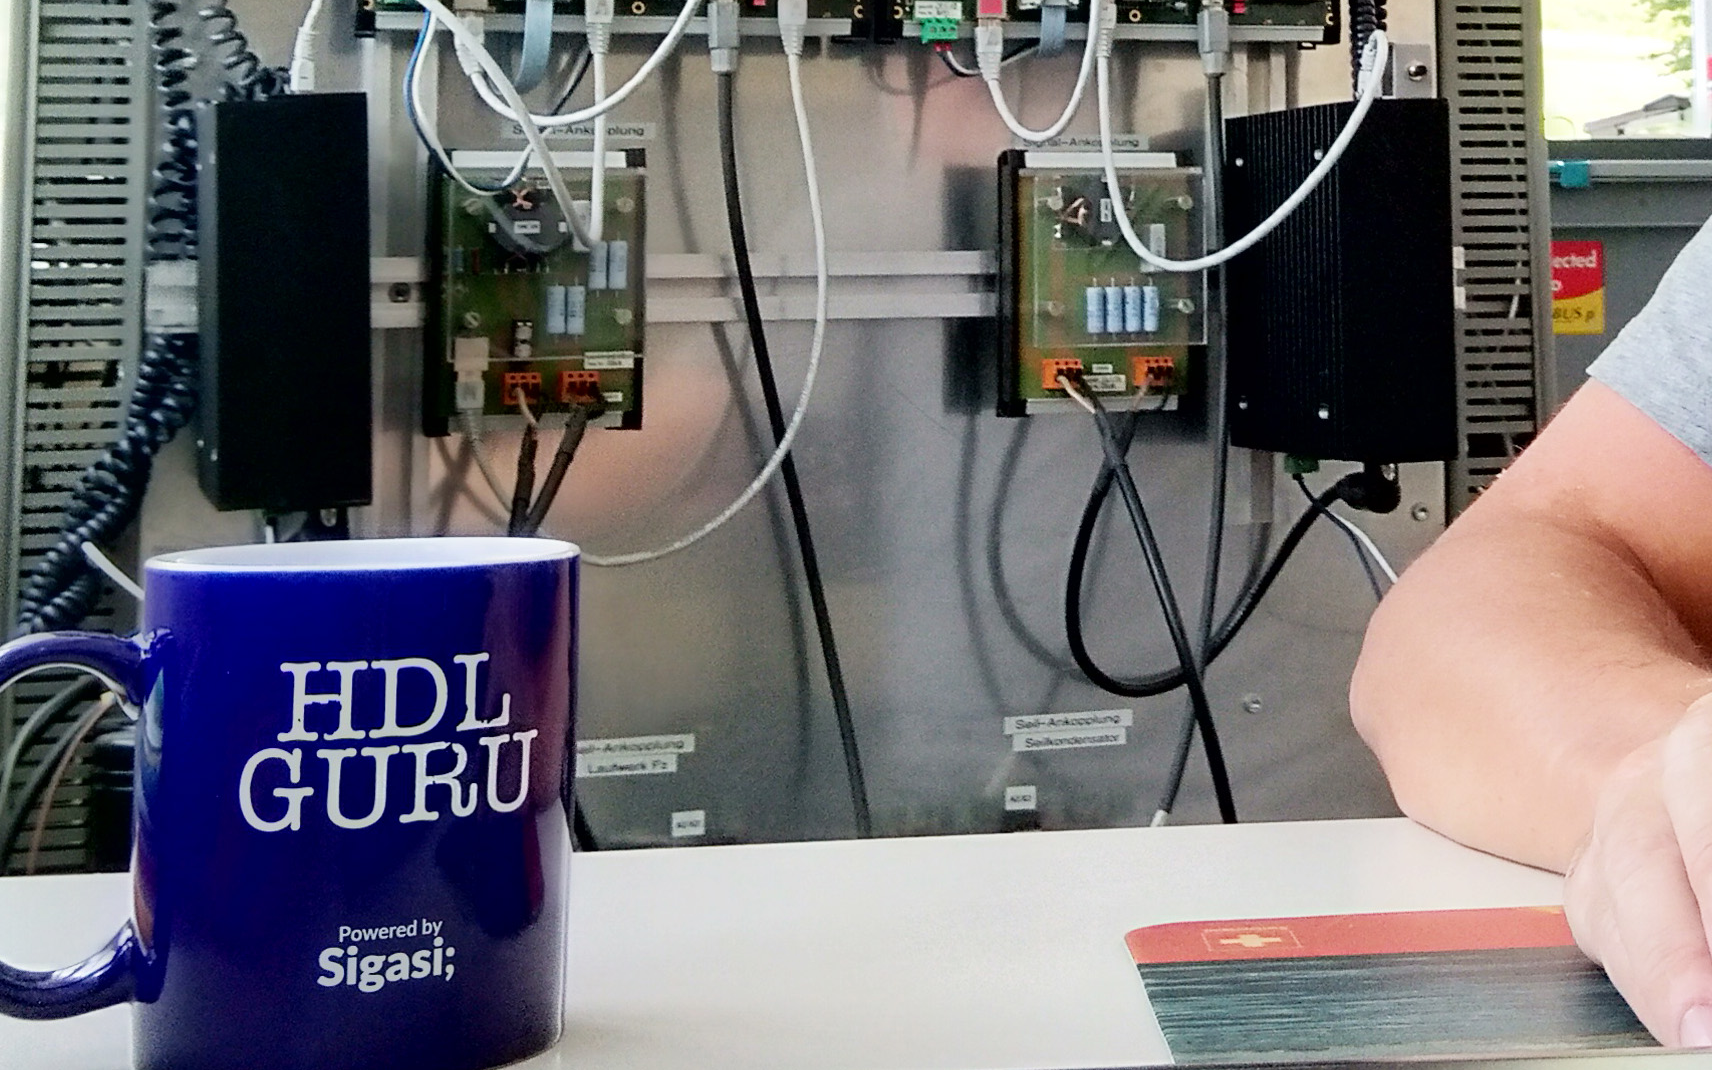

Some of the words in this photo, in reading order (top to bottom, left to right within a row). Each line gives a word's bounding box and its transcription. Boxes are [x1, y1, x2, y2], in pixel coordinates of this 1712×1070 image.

[1551, 249, 1597, 268] ected
[277, 652, 511, 742] HDL
[577, 740, 685, 753] eil-Ankopplung
[238, 729, 538, 832] GURU
[338, 919, 418, 942] Powered
[421, 918, 443, 937] by
[317, 936, 456, 993] Sigasi;
